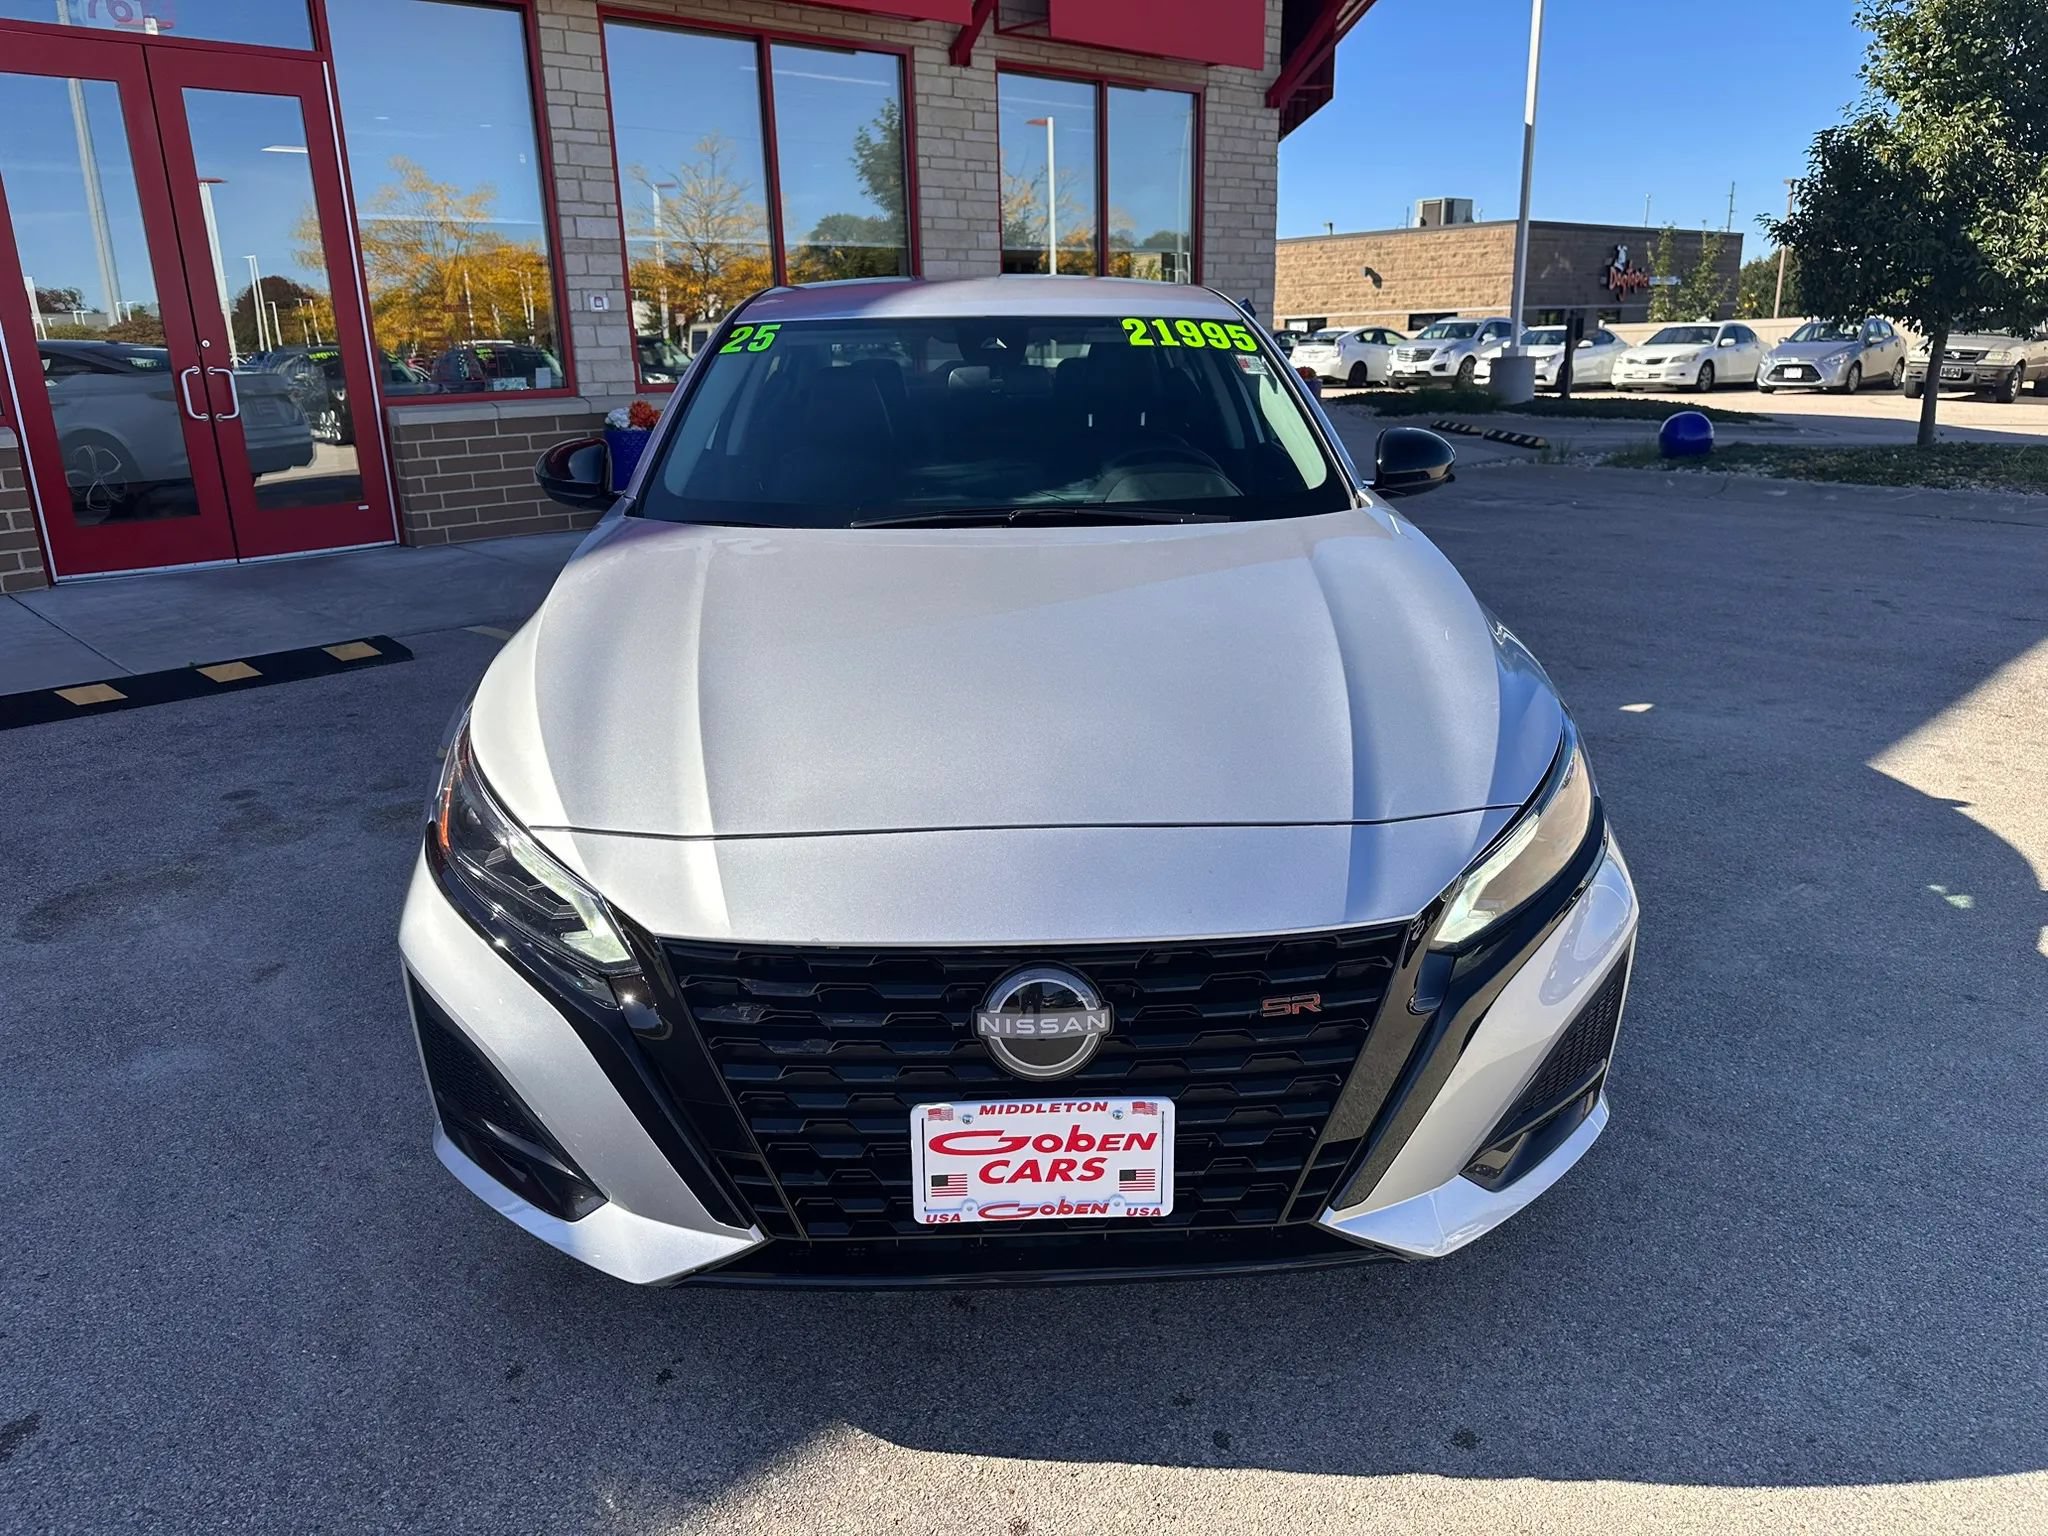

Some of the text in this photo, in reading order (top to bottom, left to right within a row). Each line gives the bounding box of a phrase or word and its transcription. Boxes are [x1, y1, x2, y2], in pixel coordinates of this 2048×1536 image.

[720, 323, 782, 354] 25
[1121, 317, 1257, 352] 21995
[1261, 992, 1322, 1018] SR
[980, 1013, 1106, 1036] NISSAN
[979, 1101, 1109, 1116] MIDDLETON
[978, 1156, 1108, 1185] CARS
[925, 1213, 961, 1224] USA
[1126, 1206, 1162, 1217] USA
